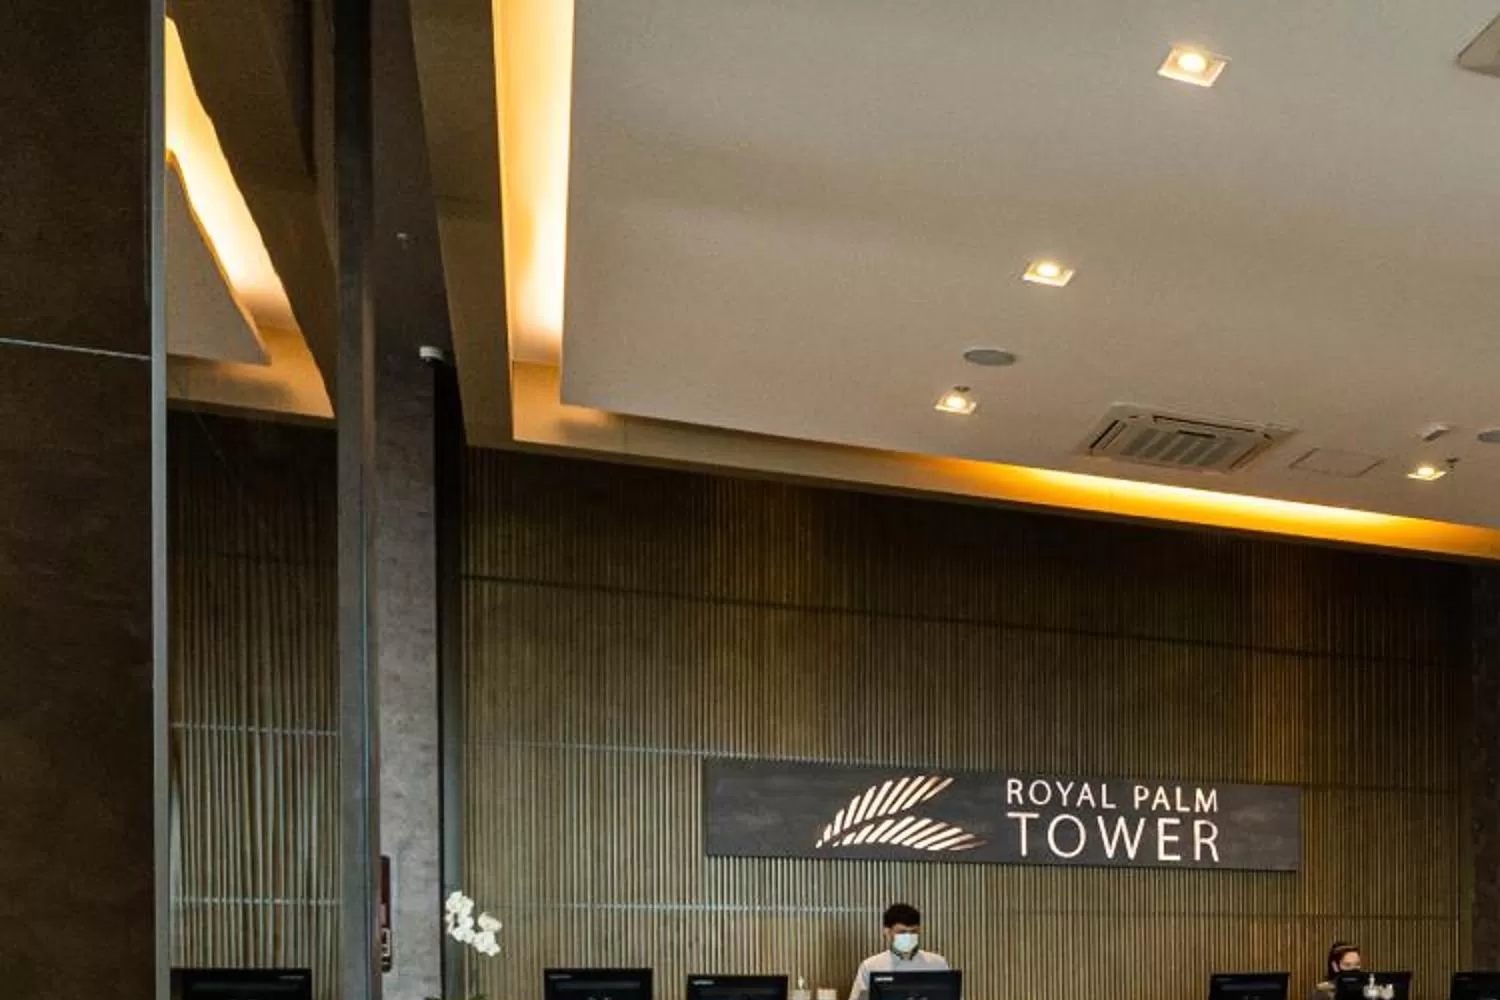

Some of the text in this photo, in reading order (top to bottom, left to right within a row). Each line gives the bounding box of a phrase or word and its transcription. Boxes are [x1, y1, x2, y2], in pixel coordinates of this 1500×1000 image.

[1006, 778, 1219, 814] ROYAL PALM
[1006, 811, 1221, 863] TOWER
